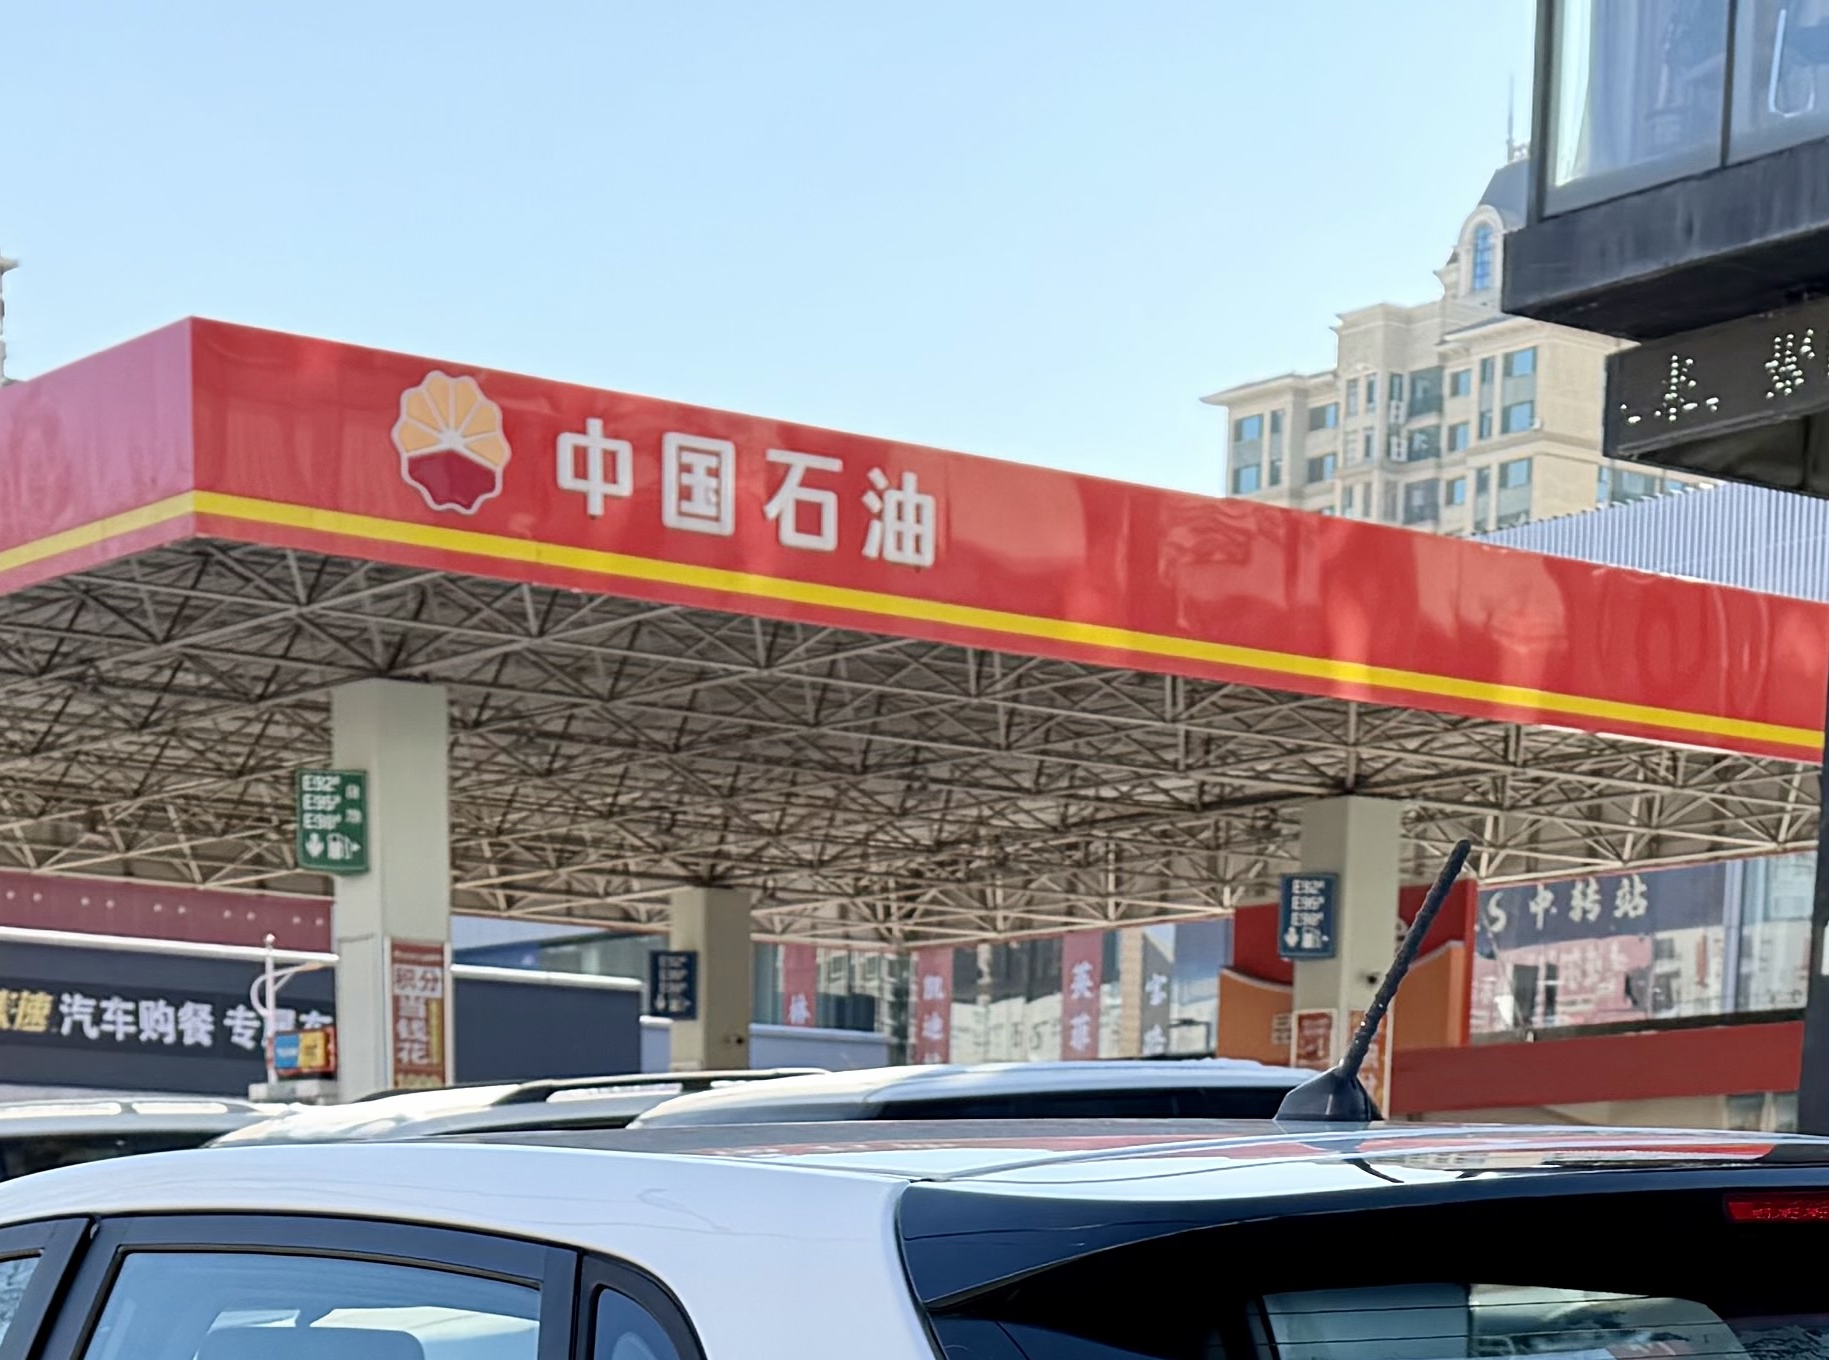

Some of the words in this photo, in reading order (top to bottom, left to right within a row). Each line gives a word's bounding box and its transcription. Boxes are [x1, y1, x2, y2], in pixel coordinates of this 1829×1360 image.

[556, 417, 937, 568] 中国石油
[58, 992, 215, 1048] 汽车购餐
